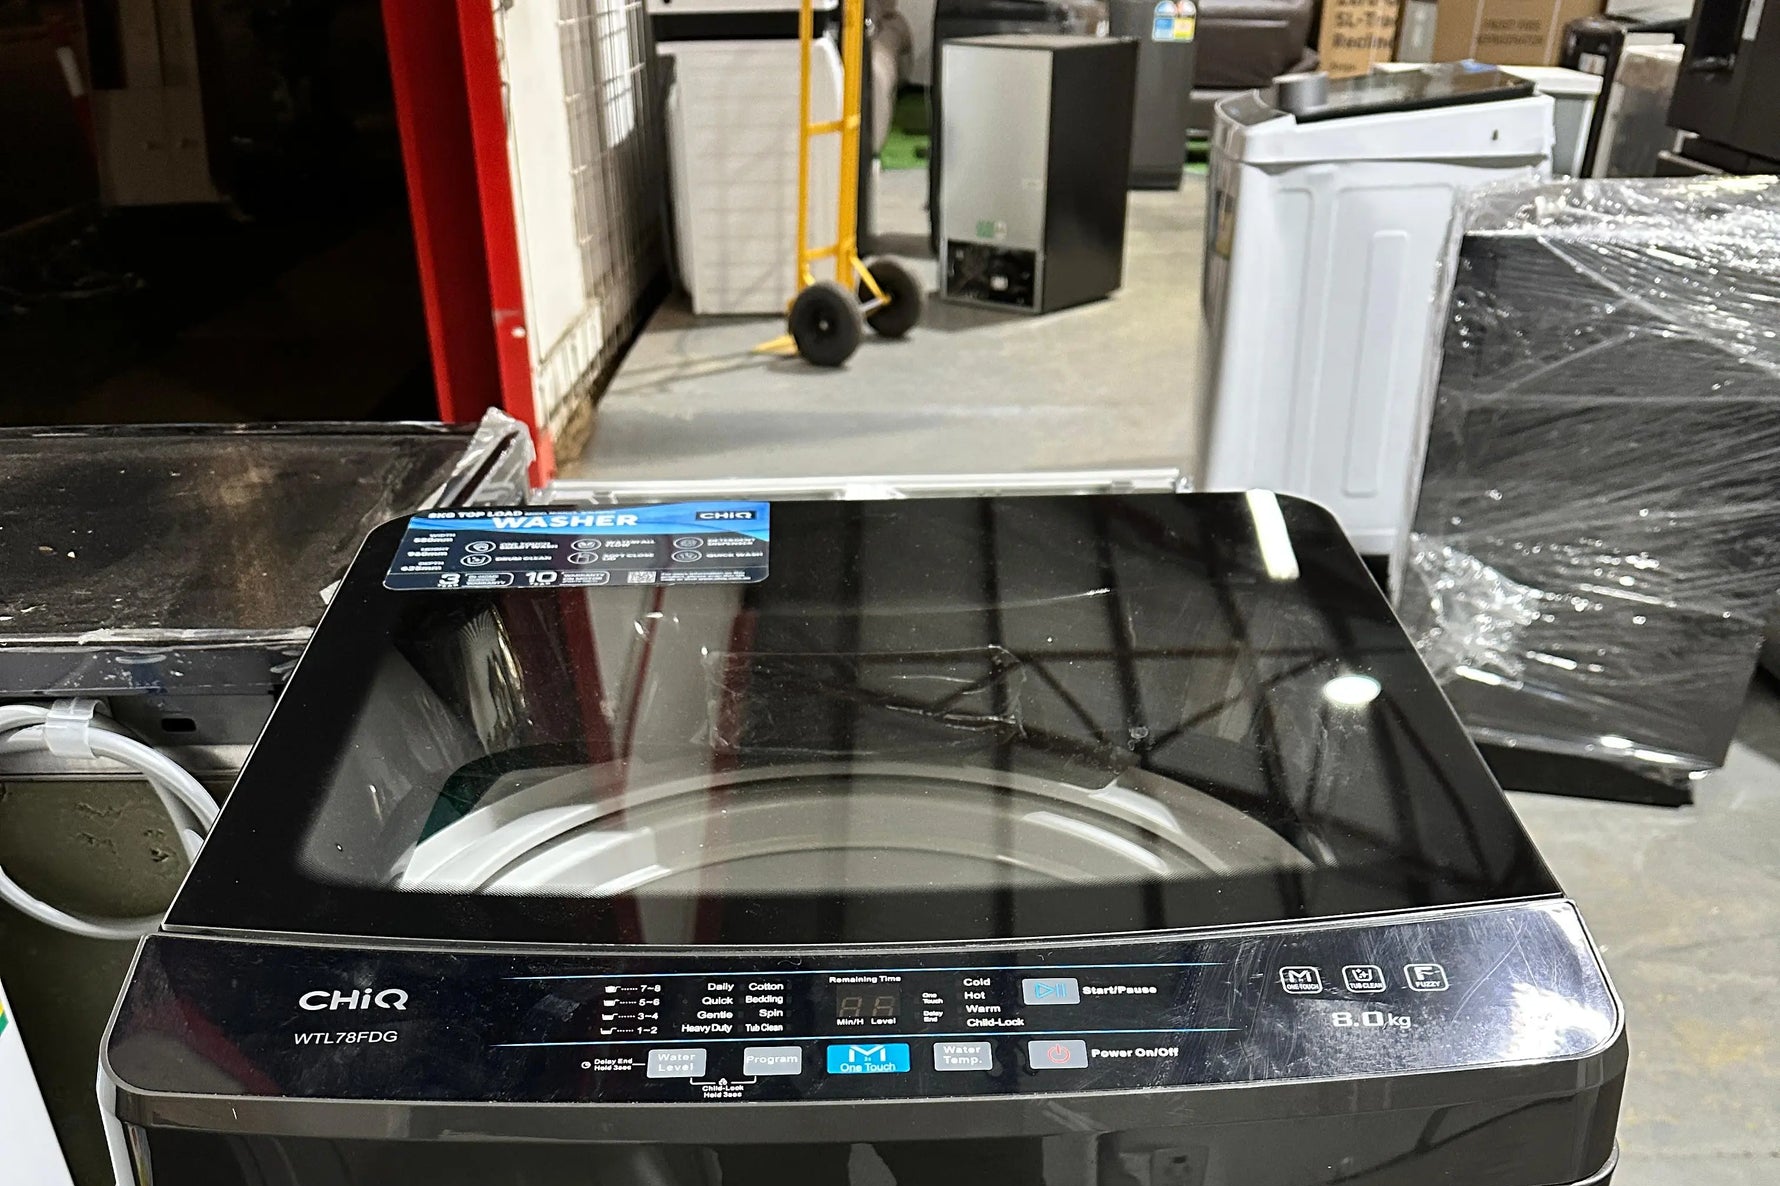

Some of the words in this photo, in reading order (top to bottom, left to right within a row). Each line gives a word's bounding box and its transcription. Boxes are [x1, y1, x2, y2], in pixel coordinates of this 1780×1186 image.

[487, 510, 523, 518] LOAD
[492, 513, 639, 529] WASHER
[439, 572, 461, 584] 3
[525, 571, 558, 583] 10
[829, 976, 878, 984] Remaining
[963, 978, 991, 986] Cold
[707, 982, 734, 992] Daily
[748, 982, 784, 991] Cotton
[1082, 986, 1157, 995] Start/Pause
[745, 995, 784, 1004] Bedding
[964, 991, 986, 1000] Hot
[702, 996, 733, 1005] Quick
[966, 1004, 1001, 1013] Warm
[697, 1010, 733, 1019] Gentle
[758, 1009, 784, 1018] Spin
[836, 1018, 864, 1026] Min/H
[870, 1017, 896, 1025] Level
[966, 1018, 1025, 1027] Child-Lock
[681, 1024, 711, 1033] Heavy
[711, 1023, 733, 1033] Duty
[745, 1024, 760, 1032] Tub
[760, 1023, 783, 1032] Clean
[294, 1031, 398, 1045] WTL78FDG
[943, 1046, 981, 1054] Water
[1091, 1049, 1133, 1058] Power
[1135, 1047, 1179, 1057] On/Off
[657, 1052, 696, 1061] Water
[746, 1054, 798, 1065] Program
[943, 1055, 982, 1065] Temp.
[658, 1062, 694, 1072] Level
[840, 1063, 862, 1072] One
[864, 1062, 896, 1072] Touch
